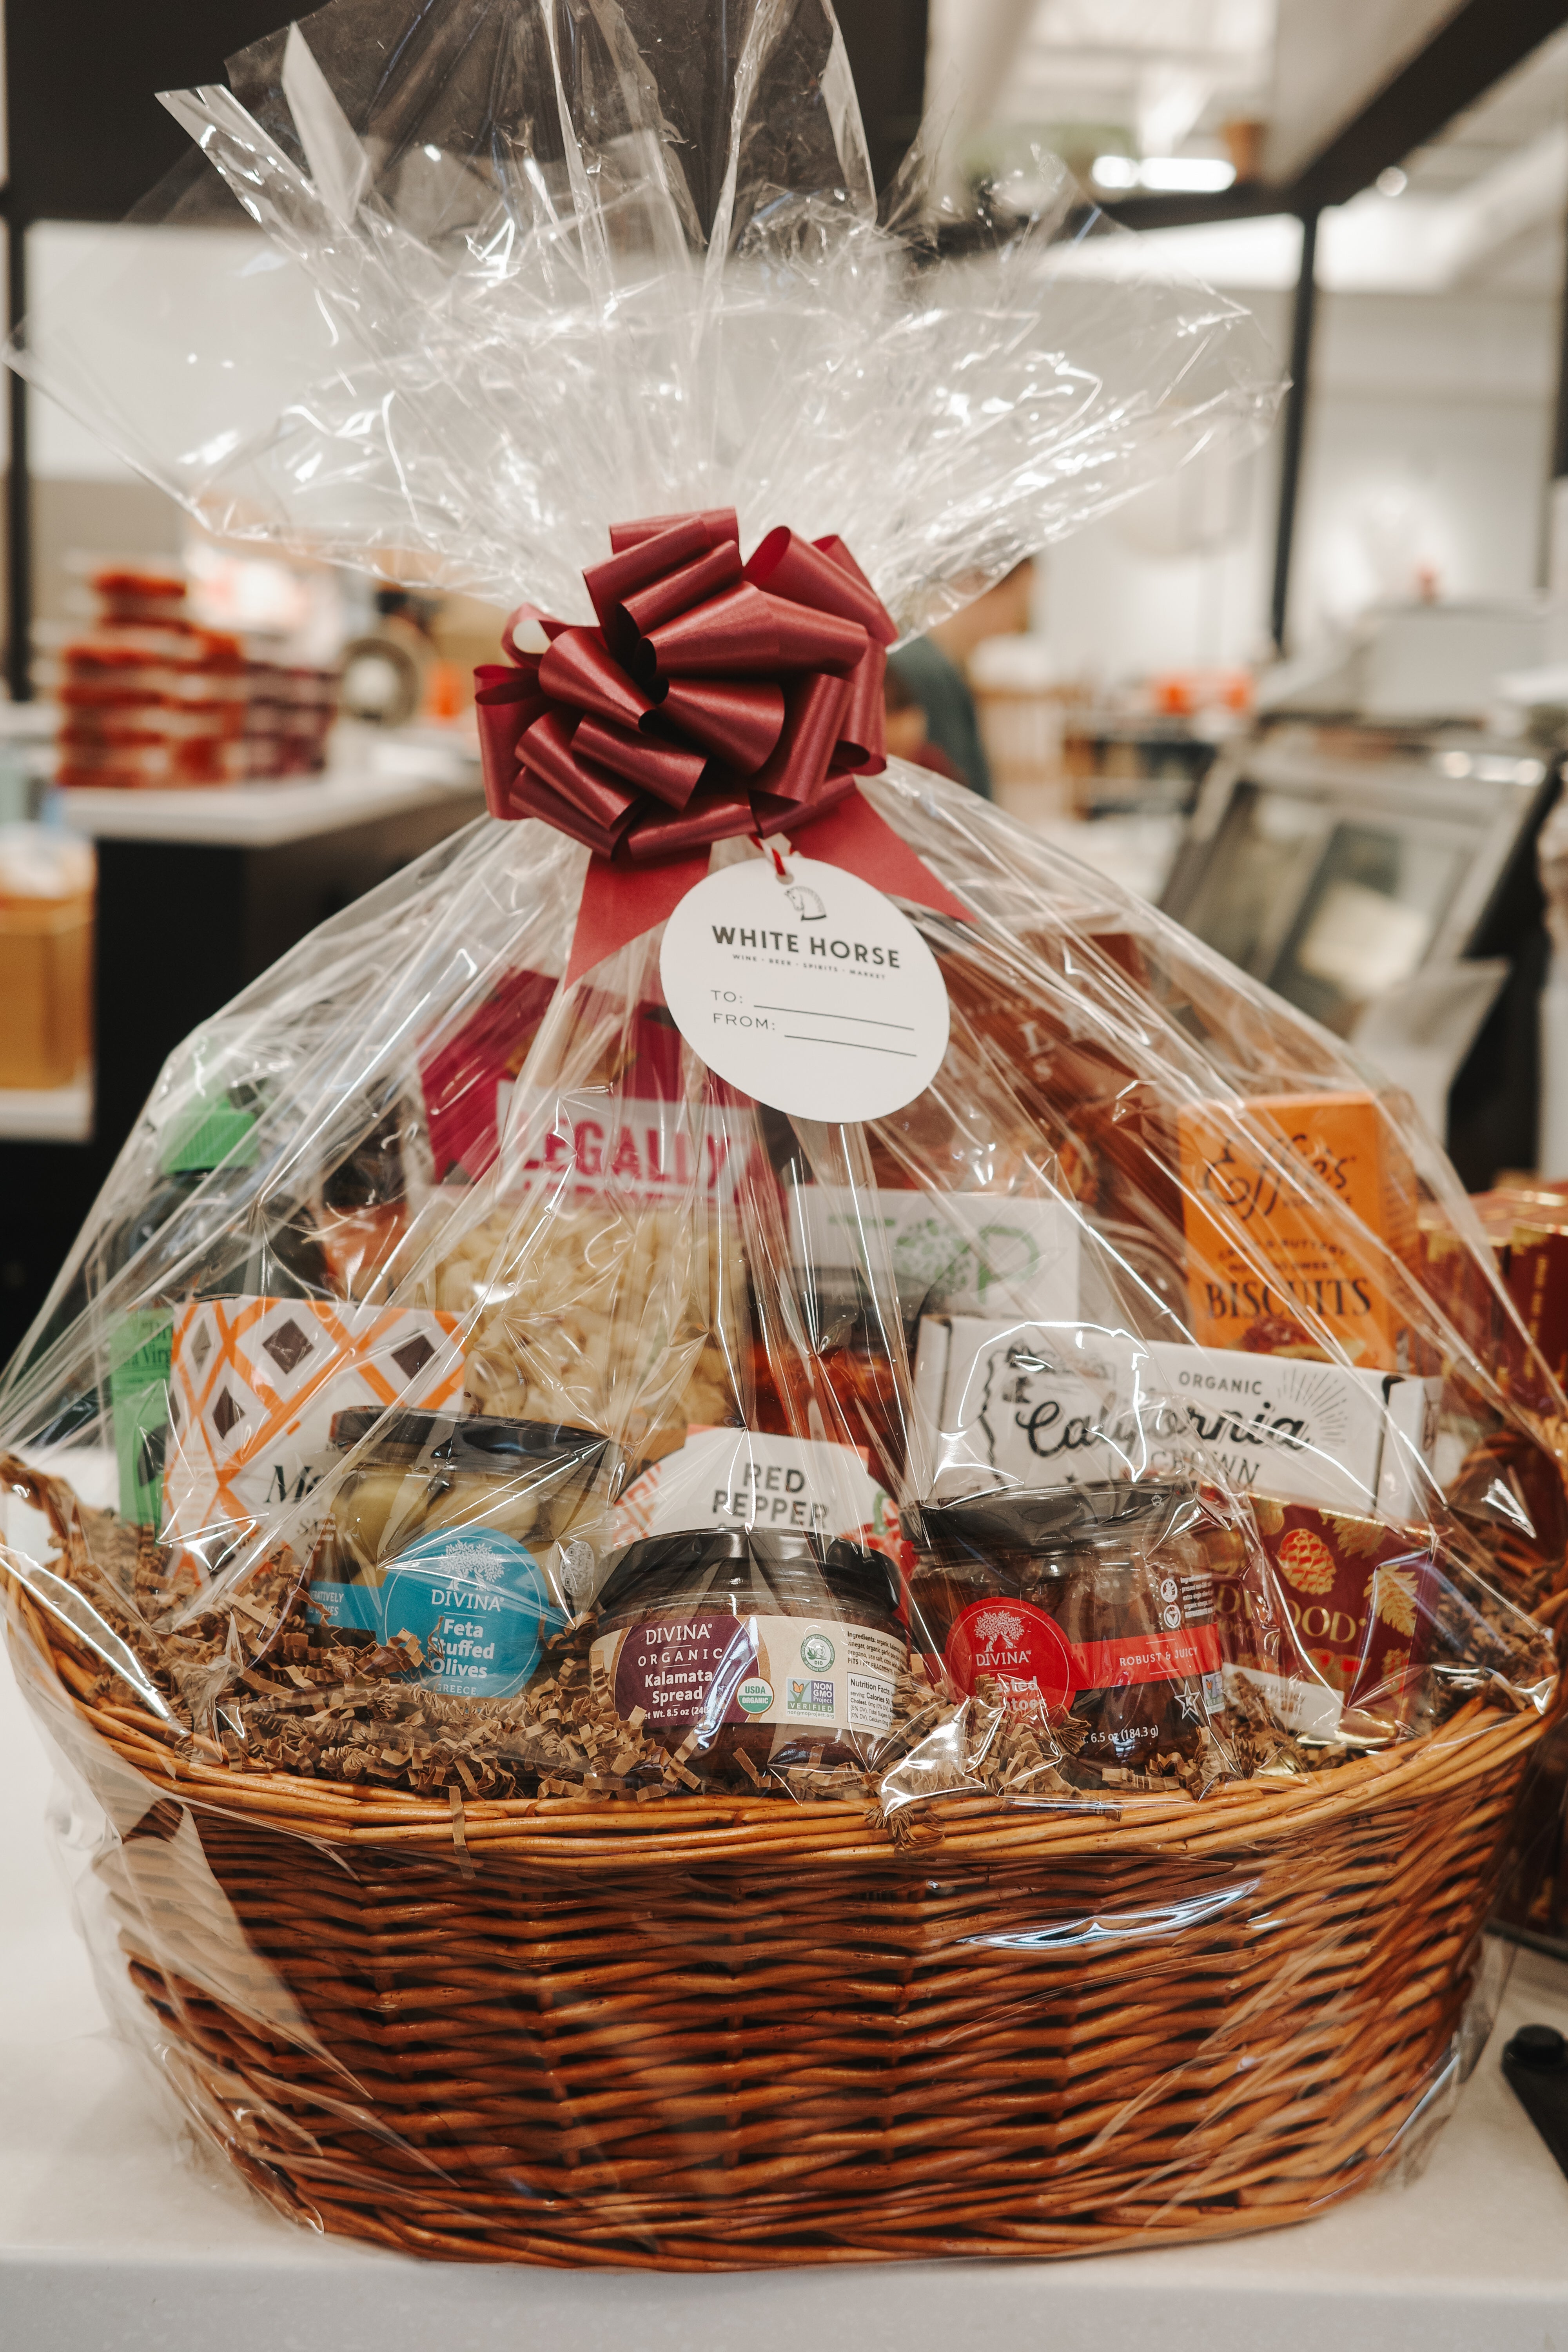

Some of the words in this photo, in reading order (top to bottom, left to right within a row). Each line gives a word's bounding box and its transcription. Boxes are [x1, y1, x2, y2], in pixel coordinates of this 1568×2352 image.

[712, 926, 799, 953] WHITE
[810, 937, 900, 969] HORSE
[804, 963, 838, 972] SPIRITS
[850, 969, 885, 979] MARKET
[711, 990, 743, 1004] TO:
[713, 1013, 775, 1030] FROM:
[1206, 1278, 1371, 1319] BISCUITS
[1179, 1372, 1262, 1396] ORGANIC
[742, 1463, 806, 1492] RED
[712, 1490, 831, 1529] PEPPER
[432, 1589, 501, 1612] DIVINA
[444, 1619, 483, 1638] Feta
[646, 1624, 711, 1645] DIVINA
[848, 1631, 876, 1642] Ingredients:
[431, 1637, 495, 1660] Stuffed
[848, 1640, 865, 1650] vinegar,
[867, 1644, 880, 1653] organic
[848, 1650, 867, 1658] oregano,
[638, 1648, 723, 1667] ORGANIC
[976, 1651, 1029, 1666] DIVINA
[1119, 1652, 1161, 1666] ROBUST
[1165, 1651, 1171, 1661] &
[1175, 1646, 1198, 1659] JUICY
[430, 1657, 487, 1679] Olives
[645, 1670, 713, 1688] Kalamata
[813, 1682, 832, 1691] NON
[851, 1679, 877, 1691] Nutrition
[878, 1684, 890, 1695] Facts
[436, 1683, 477, 1695] GREECE
[652, 1686, 703, 1707] Spread
[866, 1692, 884, 1703] Calories
[790, 1702, 833, 1711] VERIFIED
[1185, 1696, 1193, 1707] K
[653, 1710, 665, 1719] Wt.
[667, 1708, 678, 1717] 8.5
[788, 1710, 834, 1719] nongmoproject.org
[1091, 1732, 1105, 1743] 6.5
[1108, 1733, 1119, 1741] oz
[1121, 1727, 1148, 1741] (184.3
[1150, 1724, 1158, 1738] g)
